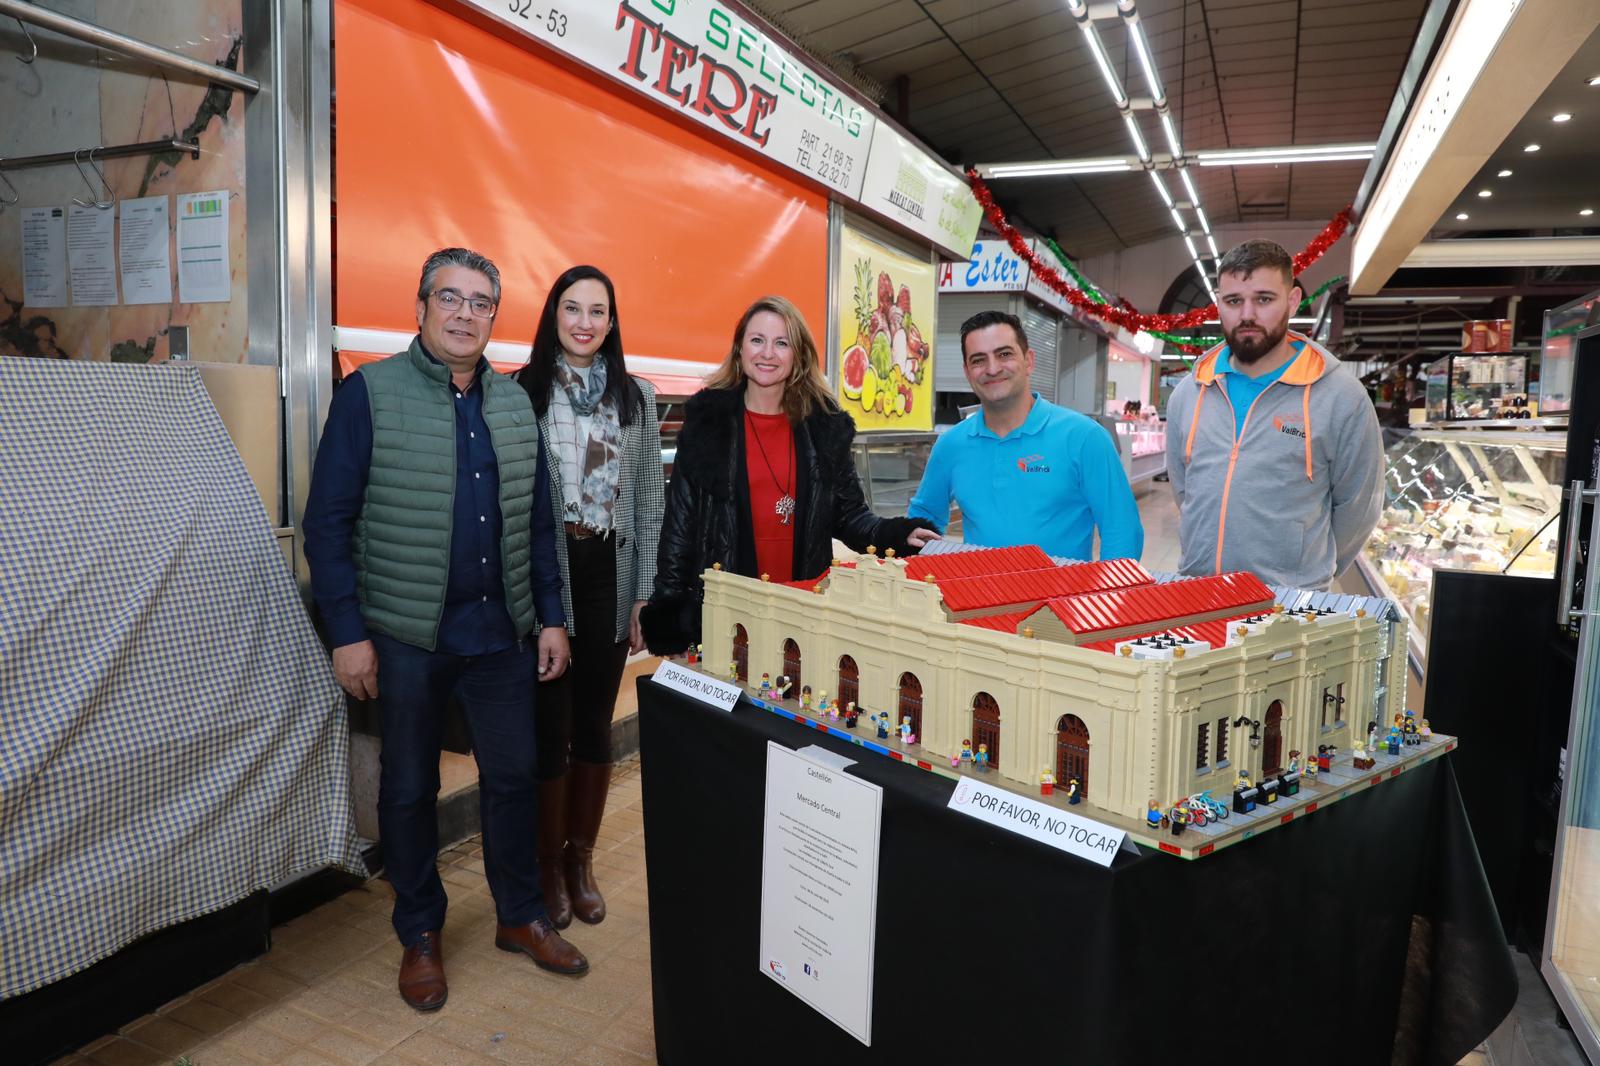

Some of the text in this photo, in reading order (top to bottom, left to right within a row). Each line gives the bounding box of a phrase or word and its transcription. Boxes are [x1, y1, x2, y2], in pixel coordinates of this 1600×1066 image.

[547, 8, 568, 38] 53
[614, 0, 778, 149] TERE
[706, 8, 862, 138] SELECTAS
[822, 143, 833, 160] 21
[817, 161, 829, 178] 22
[829, 167, 839, 184] 32
[840, 172, 850, 189] 70
[889, 189, 908, 207] MERCAT
[938, 262, 953, 287] A
[966, 243, 1019, 287] Ester
[664, 669, 679, 681] POR
[701, 683, 714, 696] NO
[713, 687, 738, 704] TOCAR
[796, 792, 841, 820] Mercado Central
[971, 791, 999, 812] POR
[998, 800, 1041, 830] FAVOR,
[1043, 817, 1067, 835] NO
[1068, 824, 1118, 855] TOCAR
